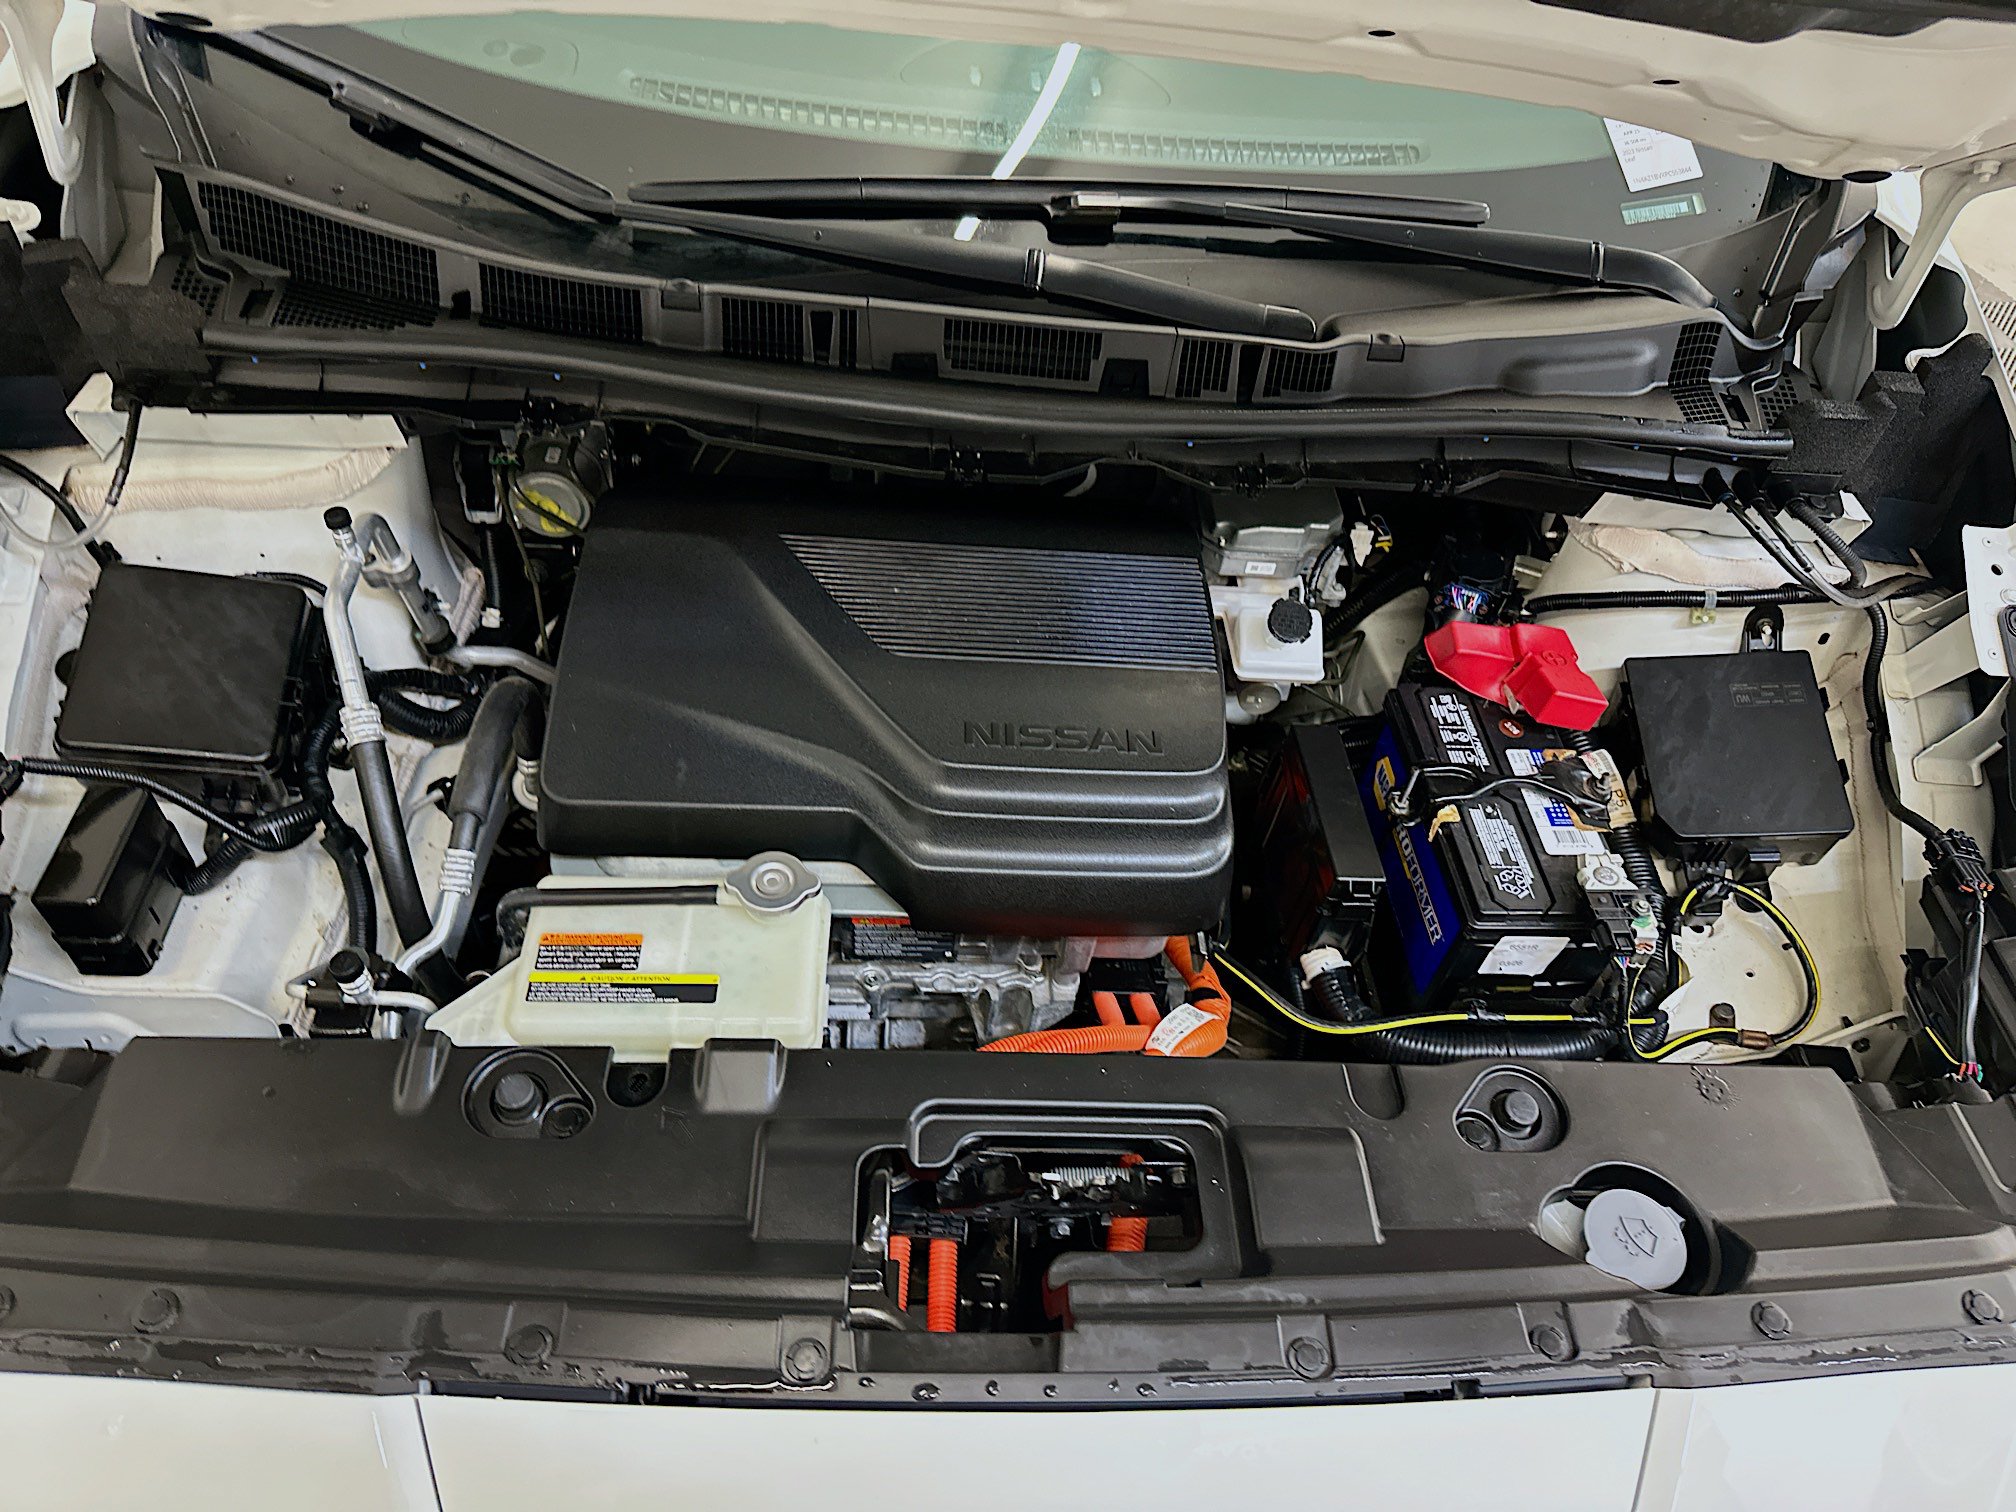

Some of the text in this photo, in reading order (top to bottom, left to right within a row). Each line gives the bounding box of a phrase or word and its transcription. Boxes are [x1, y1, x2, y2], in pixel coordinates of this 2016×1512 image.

[964, 721, 1160, 757] NISSAN
[1611, 789, 1628, 808] P5
[1397, 822, 1442, 944] ROFORMER
